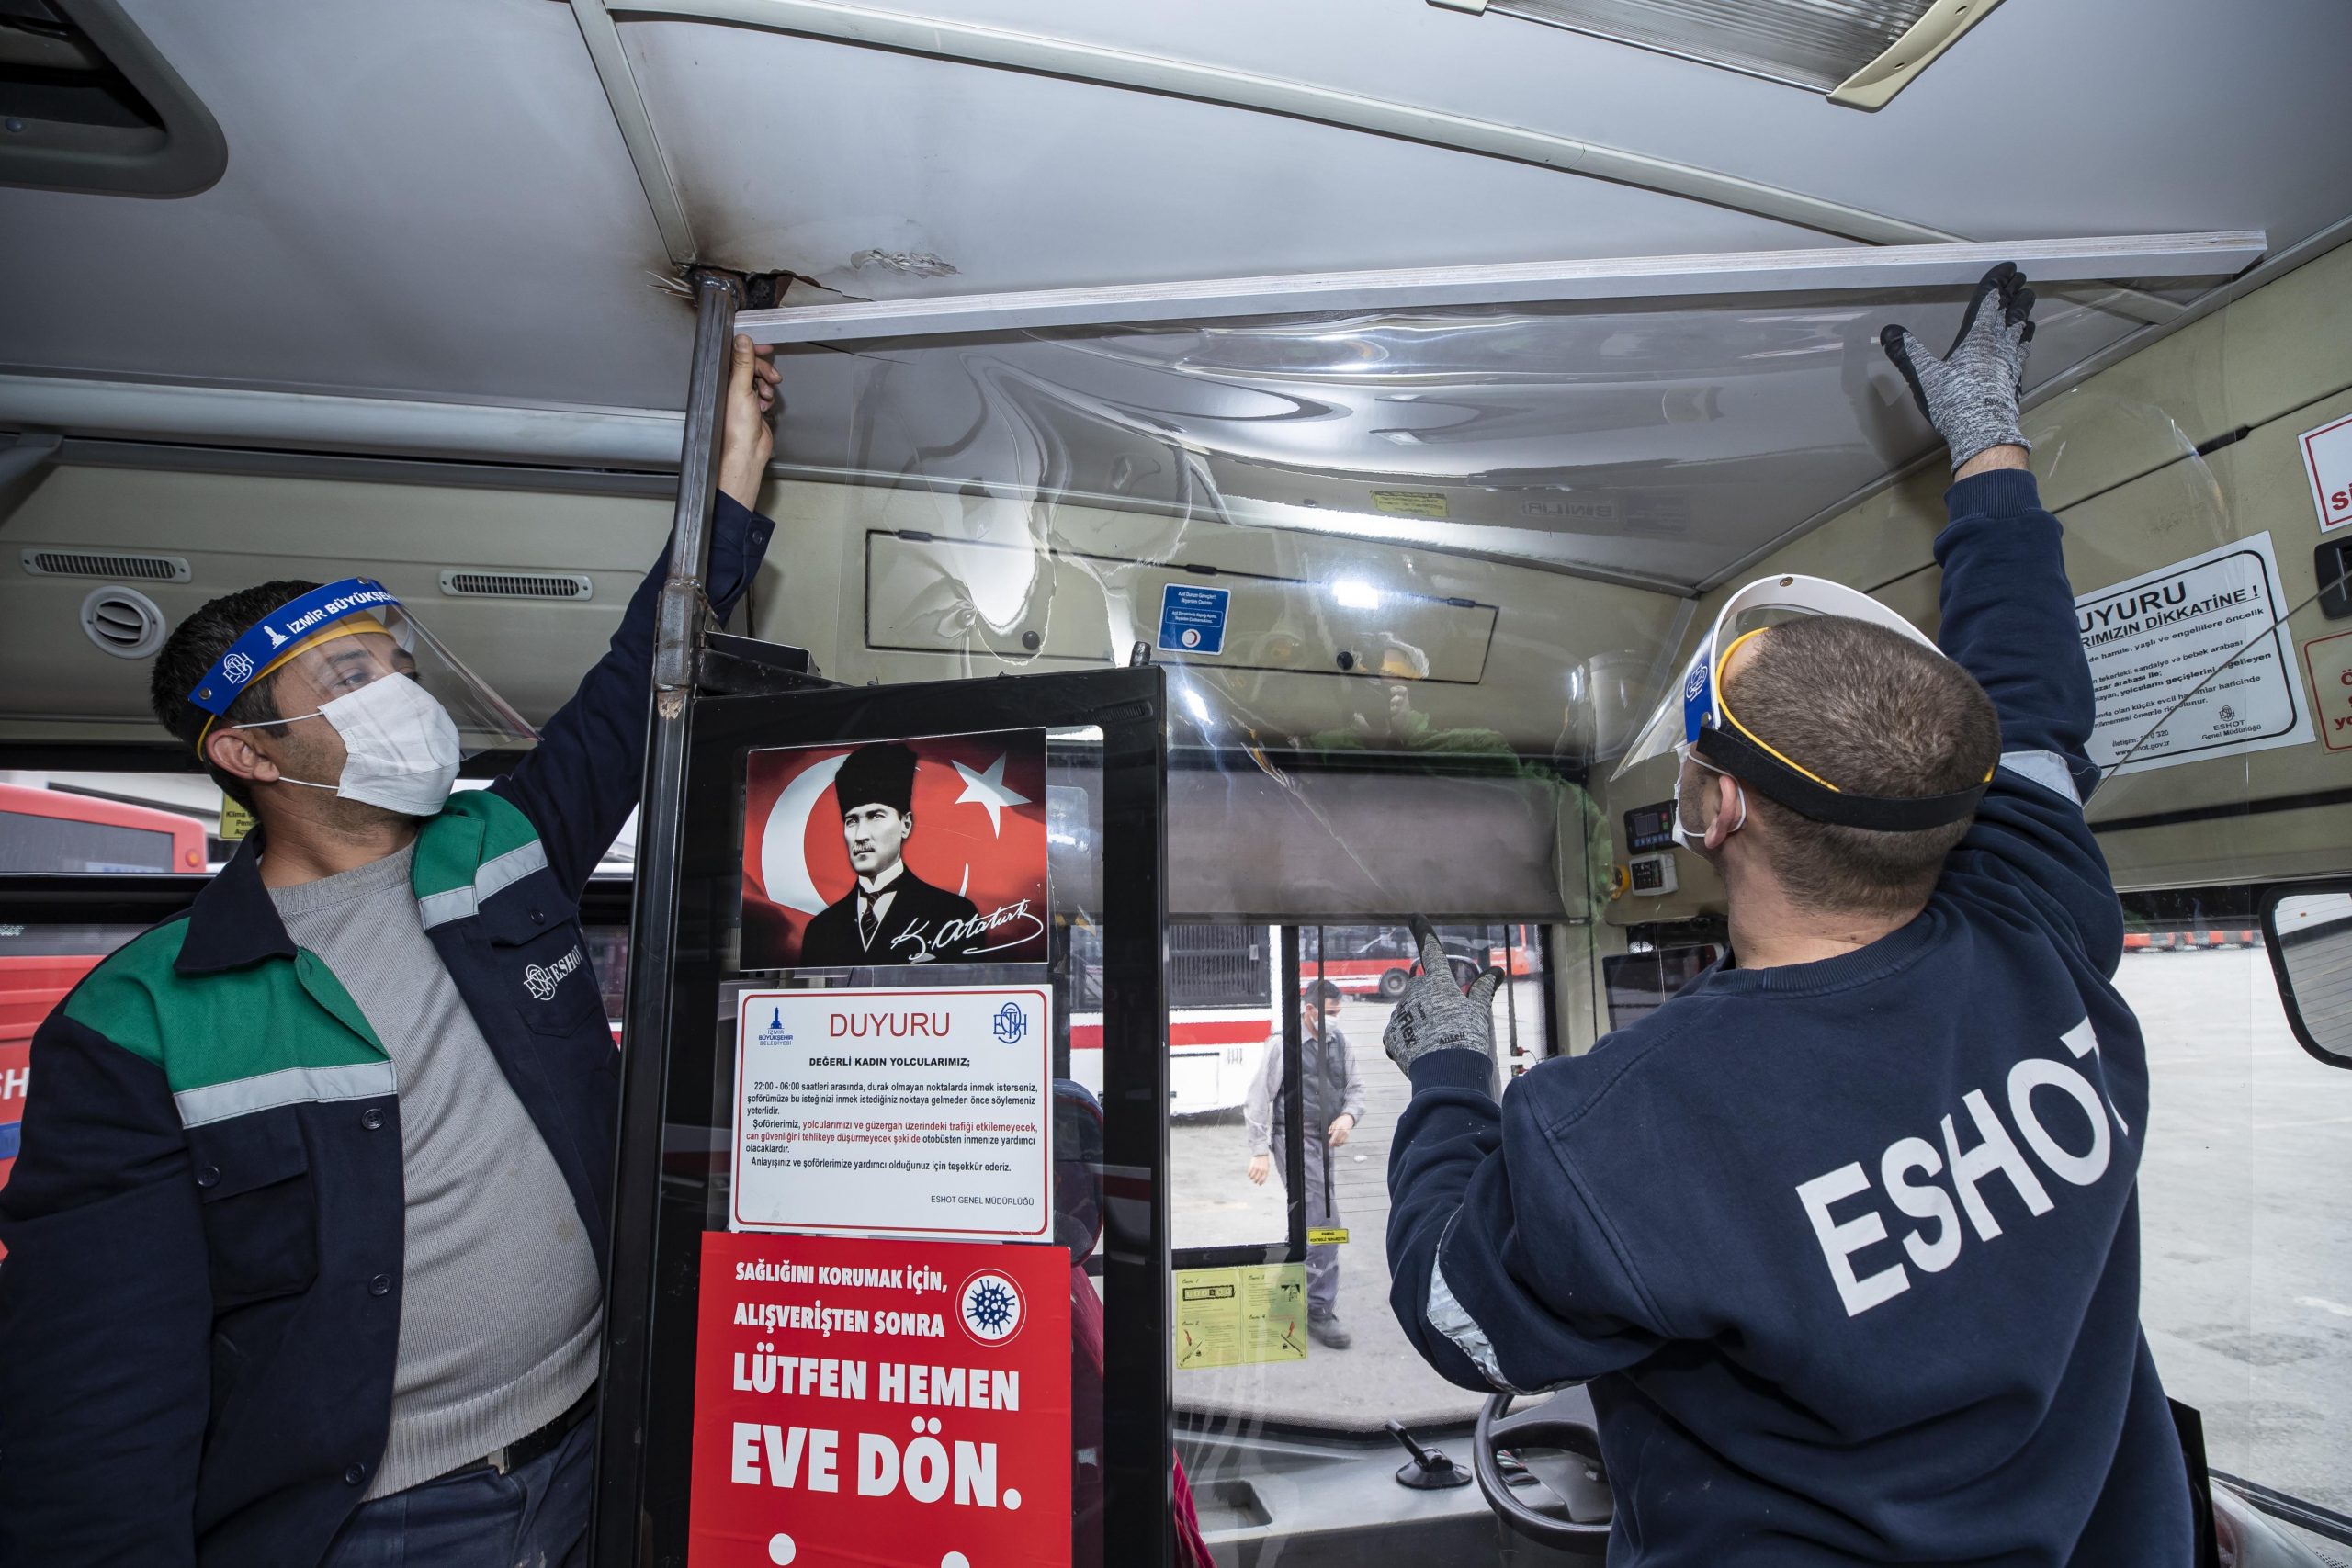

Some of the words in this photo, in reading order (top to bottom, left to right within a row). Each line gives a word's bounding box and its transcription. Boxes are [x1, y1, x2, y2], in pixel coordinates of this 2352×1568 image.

[2079, 581, 2187, 633] UYURU
[286, 609, 328, 635] İZMİR
[2081, 622, 2141, 647] RIMIZIN
[2145, 588, 2247, 629] DİKKATİNE
[2158, 635, 2169, 643] ve
[2172, 620, 2223, 639] engellilere
[2225, 608, 2264, 624] öncelik
[2183, 649, 2209, 660] bebek
[2211, 640, 2243, 653] arabası
[2219, 652, 2271, 670] gelleyen
[2095, 684, 2111, 693] azar
[2095, 716, 2132, 728] nilmemesi
[2213, 719, 2245, 731] ESHOT
[2201, 731, 2222, 740] Genel
[2223, 724, 2262, 737] Müdürlüğü
[830, 1012, 950, 1038] DUYURU
[808, 1055, 852, 1066] DEĞERLİ
[854, 1057, 887, 1066] KADIN
[889, 1057, 970, 1068] YOLCULARIMIZ;
[753, 1081, 774, 1090] 22:00
[779, 1081, 800, 1090] 06:00
[801, 1082, 829, 1091] saatleri
[831, 1082, 865, 1092] arasında,
[867, 1082, 889, 1091] durak
[891, 1082, 924, 1094] olmayan
[926, 1082, 967, 1092] noktalarda
[970, 1082, 994, 1092] inmek
[996, 1082, 1038, 1093] isterseniz,
[747, 1094, 789, 1104] şoförümüze
[790, 1094, 800, 1103] bu
[801, 1094, 834, 1105] isteğinizi
[835, 1095, 858, 1103] inmek
[859, 1095, 898, 1106] istediğiniz
[899, 1095, 929, 1106] noktaya
[931, 1096, 968, 1107] gelmeden
[970, 1096, 989, 1105] önce
[991, 1096, 1036, 1107] söylemeniz
[747, 1106, 780, 1117] yeterlidir.
[752, 1119, 801, 1130] Şoförlerimiz,
[802, 1120, 853, 1131] yolcularımızı
[854, 1122, 864, 1130] ve
[865, 1120, 902, 1132] güzergah
[905, 1121, 947, 1131] üzerindeki
[949, 1122, 974, 1133] trafiği
[976, 1122, 1038, 1134] etkilemeyecek,
[761, 1132, 800, 1143] güvenliğini
[802, 1133, 835, 1144] tehlikeye
[837, 1133, 891, 1144] düşürmeyecek
[893, 1134, 921, 1145] şekilde
[922, 1134, 962, 1144] otobüsten
[964, 1134, 1000, 1145] inmenize
[1001, 1135, 1035, 1146] yardımcı
[745, 1144, 790, 1154] olacaklardır.
[751, 1156, 791, 1168] Anlayışınız
[803, 1158, 853, 1169] şoförlerimize
[854, 1159, 887, 1170] yardımcı
[888, 1160, 930, 1171] olduğunuz
[932, 1161, 946, 1172] için
[948, 1161, 983, 1172] teşekkür
[984, 1162, 1012, 1172] ederiz.
[931, 1195, 956, 1204] ESHOT
[957, 1196, 983, 1205] GENEL
[985, 1196, 1035, 1206] MÜDÜRLÜĞÜ
[735, 1258, 814, 1284] SAĞLIĞINI
[818, 1266, 903, 1289] KORUMAK
[906, 1264, 948, 1295] İÇİN,
[734, 1299, 869, 1337] ALIŞVERİŞTEN
[874, 1311, 945, 1337] SONRA
[733, 1342, 867, 1401] LÜTFEN
[878, 1362, 1020, 1412] HEMEN
[731, 1421, 839, 1493] EVE
[858, 1416, 1022, 1510] DÖN.
